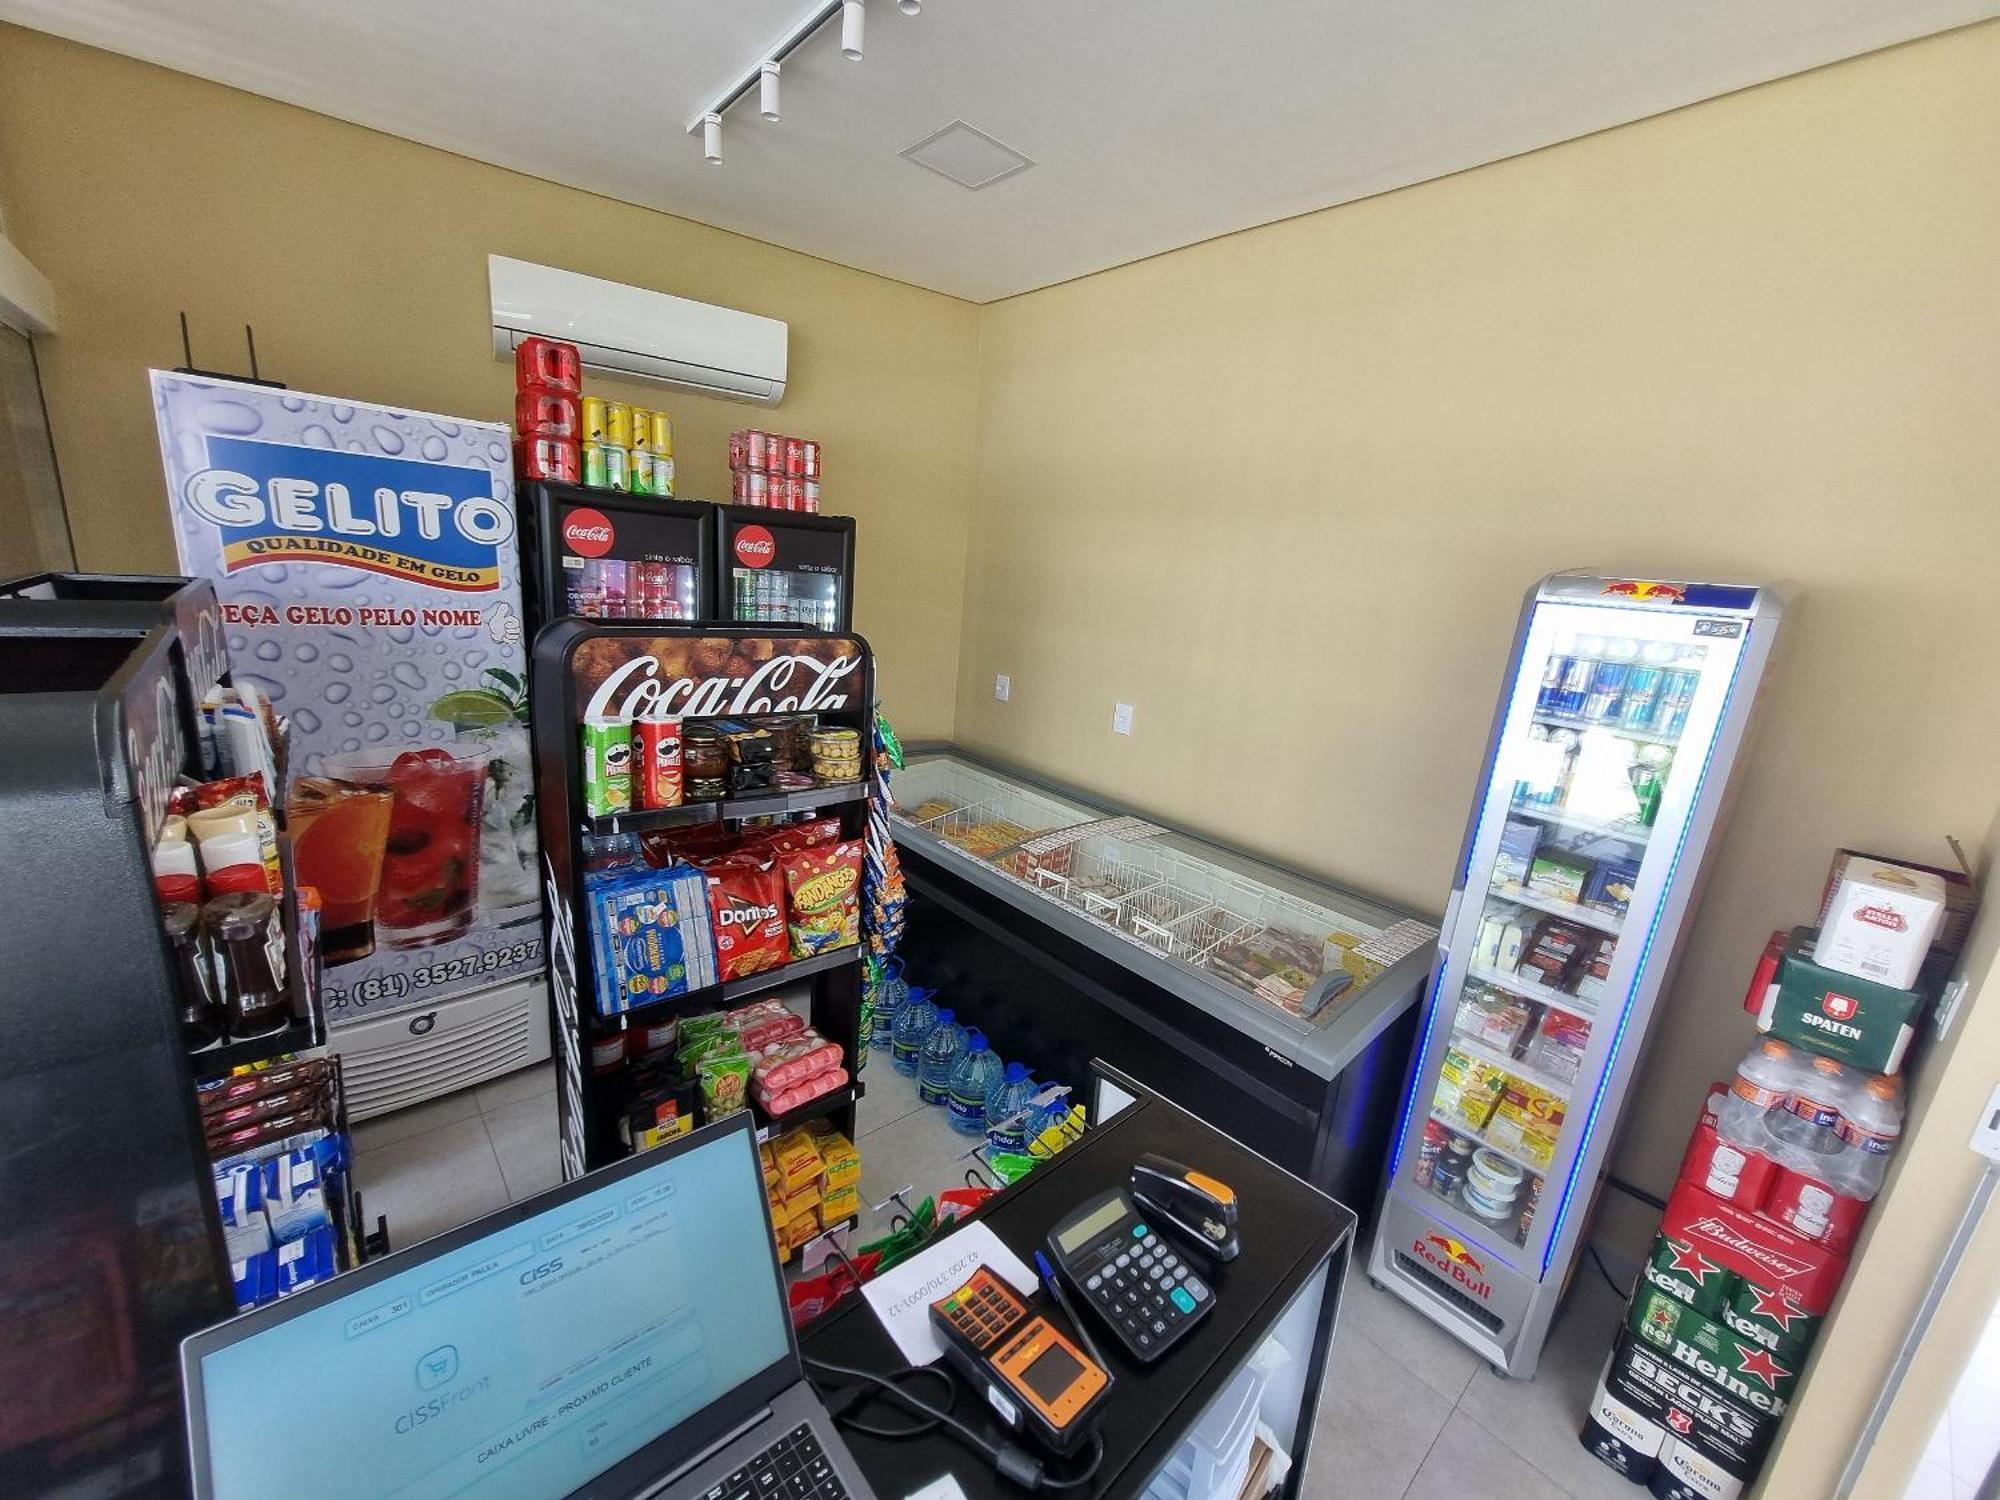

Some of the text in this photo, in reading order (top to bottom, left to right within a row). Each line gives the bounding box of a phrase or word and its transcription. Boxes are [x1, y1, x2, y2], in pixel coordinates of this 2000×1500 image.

[185, 469, 514, 546] GELITO
[567, 524, 611, 541] Coca-Cola
[246, 538, 480, 584] QUALIDADE EM GELO
[286, 606, 352, 626] GELO
[359, 608, 415, 627] PELO
[422, 609, 482, 627] NOME
[719, 904, 778, 926] Doritos
[352, 972, 408, 1007] (81)
[414, 938, 542, 988] 3527.9237
[1801, 1012, 1862, 1040] SPATEN
[1413, 1239, 1490, 1299] Red Bull
[1698, 1216, 1800, 1276] Budweiser
[477, 1436, 513, 1464] CAIXA
[515, 1416, 550, 1443] LIVRE
[611, 1356, 653, 1387] CLIENTE
[1627, 1370, 1665, 1396] GERMAN
[1664, 1393, 1694, 1414] LAGER
[1693, 1411, 1720, 1430] PURE
[1719, 1428, 1745, 1446] MALT
[1631, 1353, 1755, 1439] BECK'S
[1602, 1407, 1644, 1441] Corona
[1675, 1456, 1721, 1492] Corona
